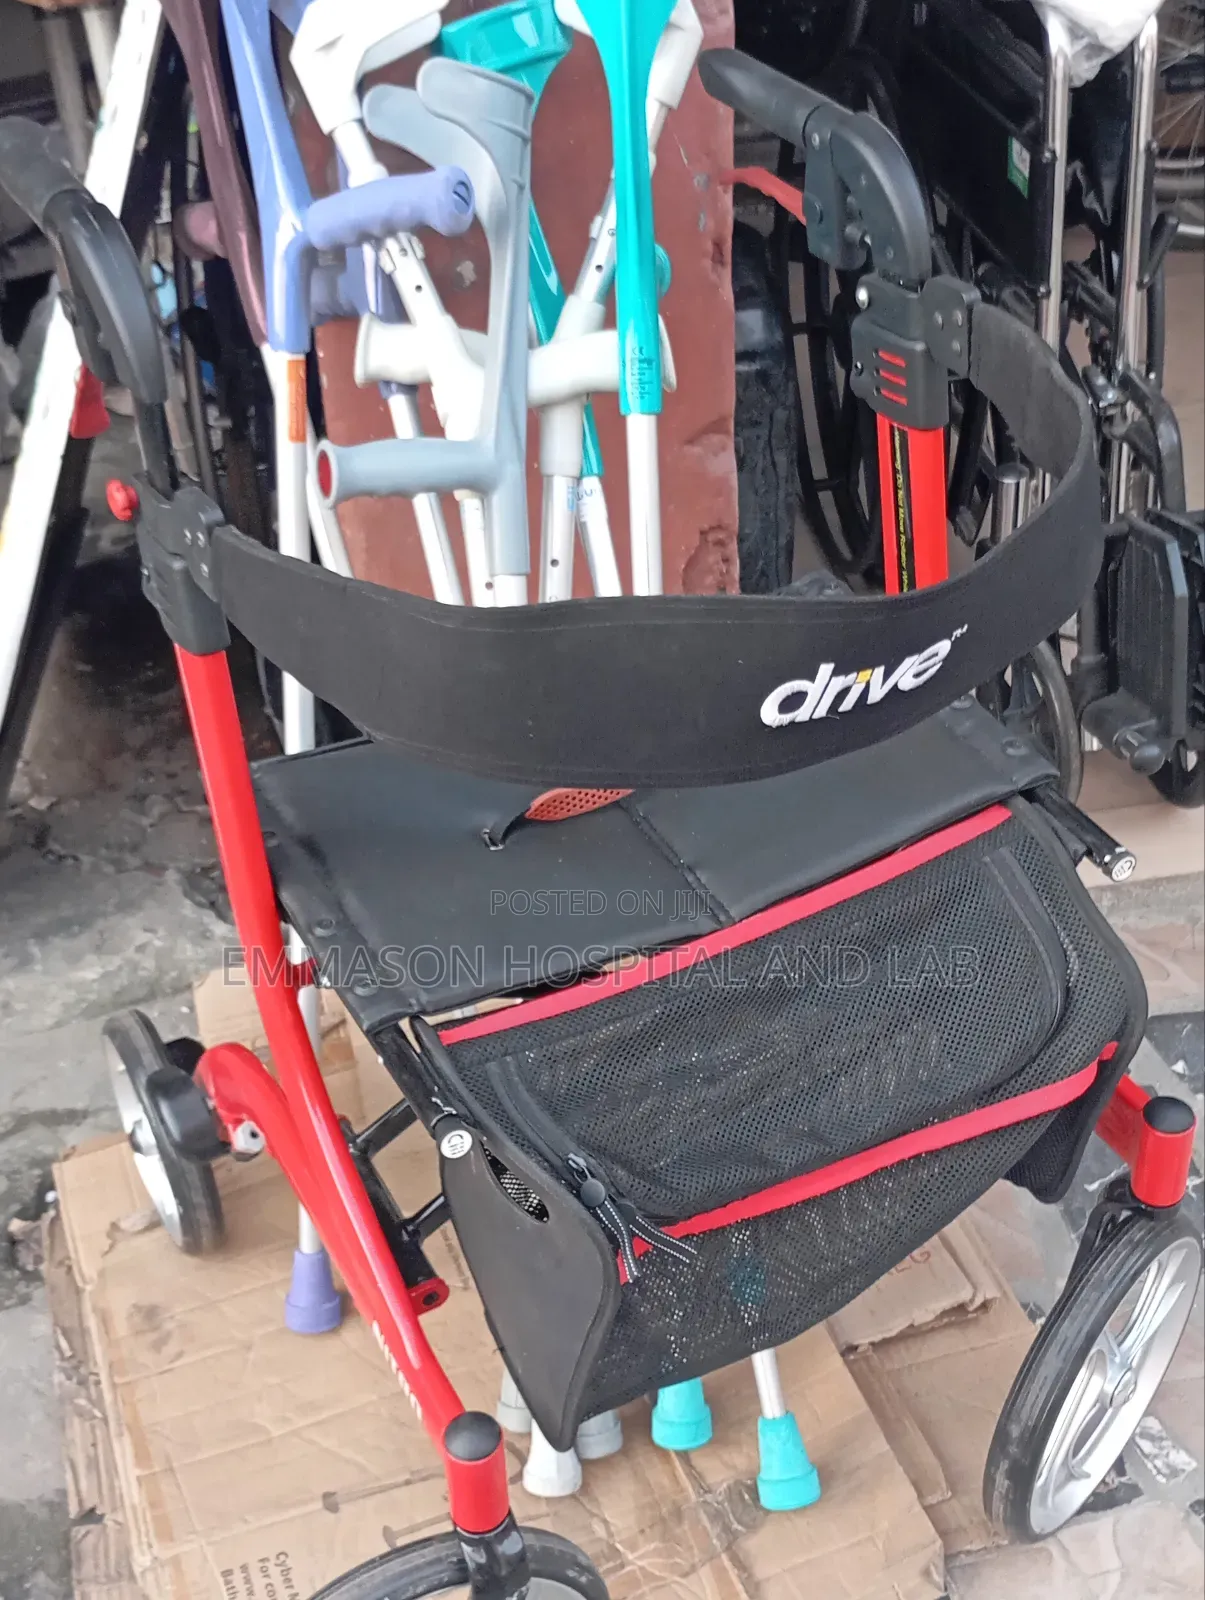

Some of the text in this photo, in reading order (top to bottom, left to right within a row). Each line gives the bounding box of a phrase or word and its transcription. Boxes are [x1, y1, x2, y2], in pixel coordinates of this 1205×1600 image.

[760, 639, 951, 728] drive
[258, 1557, 271, 1579] For
[274, 1551, 294, 1589] Cyber
